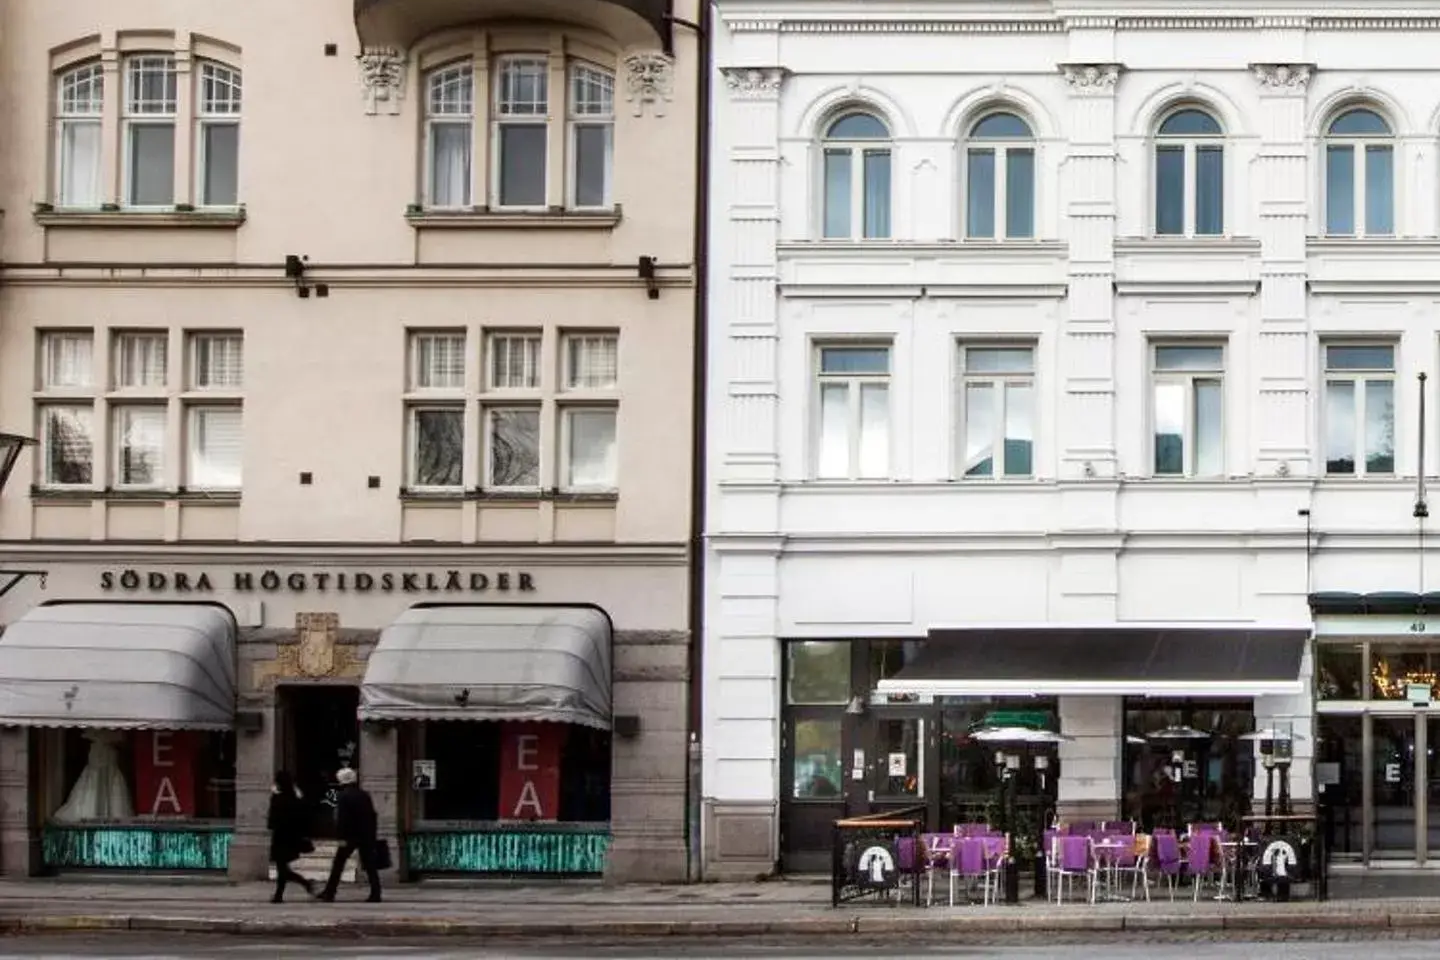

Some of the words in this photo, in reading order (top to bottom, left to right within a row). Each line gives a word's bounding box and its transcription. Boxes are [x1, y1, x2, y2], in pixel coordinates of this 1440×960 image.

[101, 570, 214, 591] SÖDRA
[234, 570, 537, 591] HÖGTIDSKLÄDER
[1385, 763, 1401, 783] E
